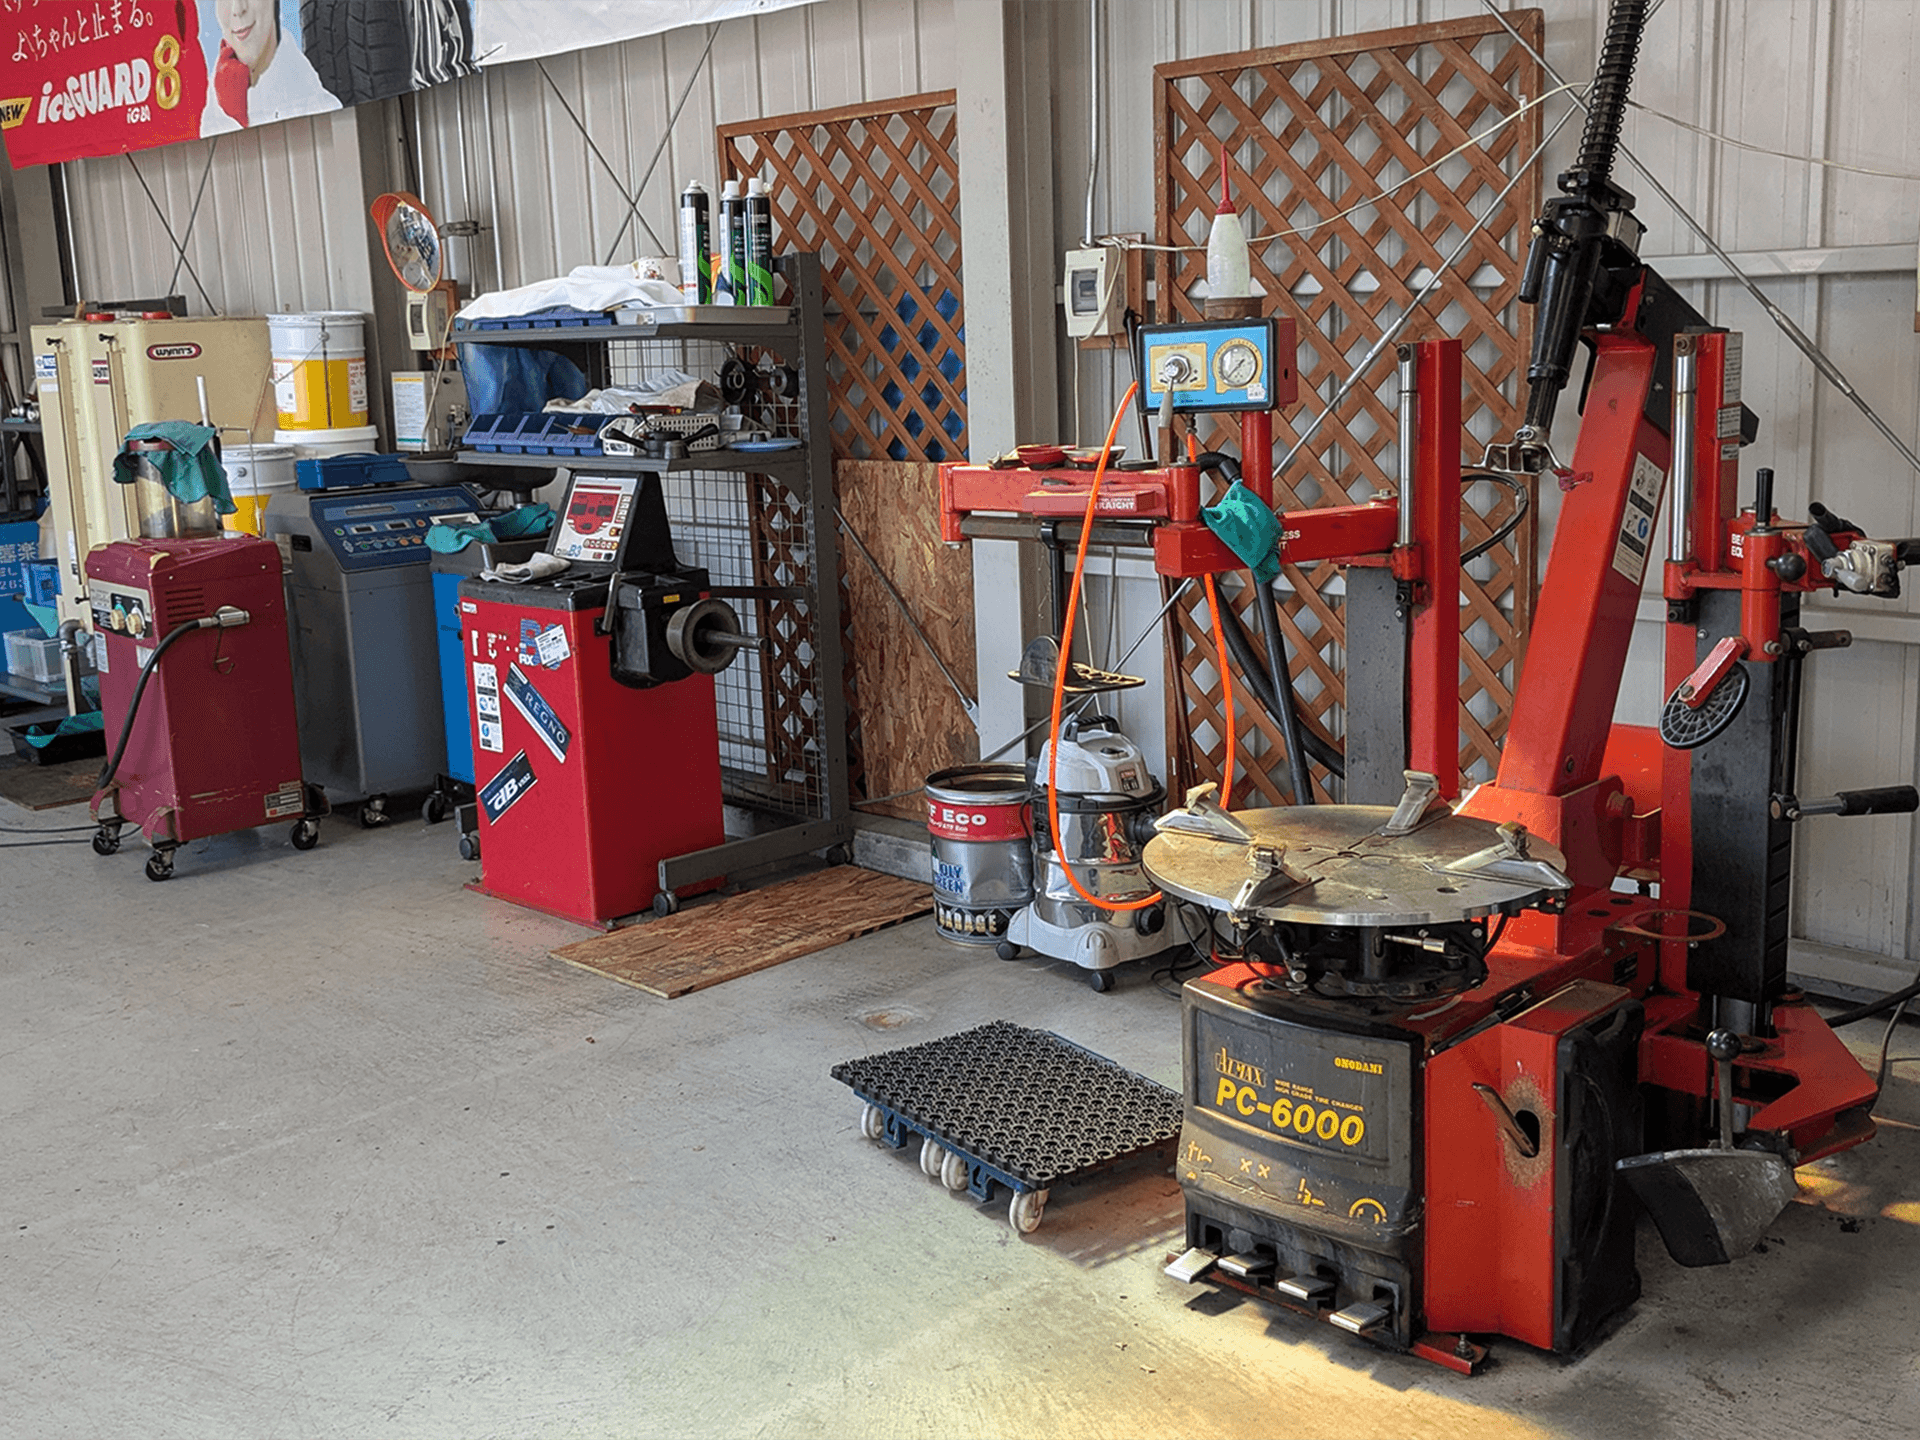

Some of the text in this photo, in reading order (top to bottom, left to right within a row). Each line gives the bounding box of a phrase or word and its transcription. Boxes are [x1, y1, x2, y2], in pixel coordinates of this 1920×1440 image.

[37, 34, 181, 124] iceGUARD 8
[525, 692, 566, 744] REGNO
[1334, 1056, 1384, 1076] ONODANI
[1215, 1076, 1365, 1147] PC-6000
[1331, 1099, 1364, 1113] CHANGER
